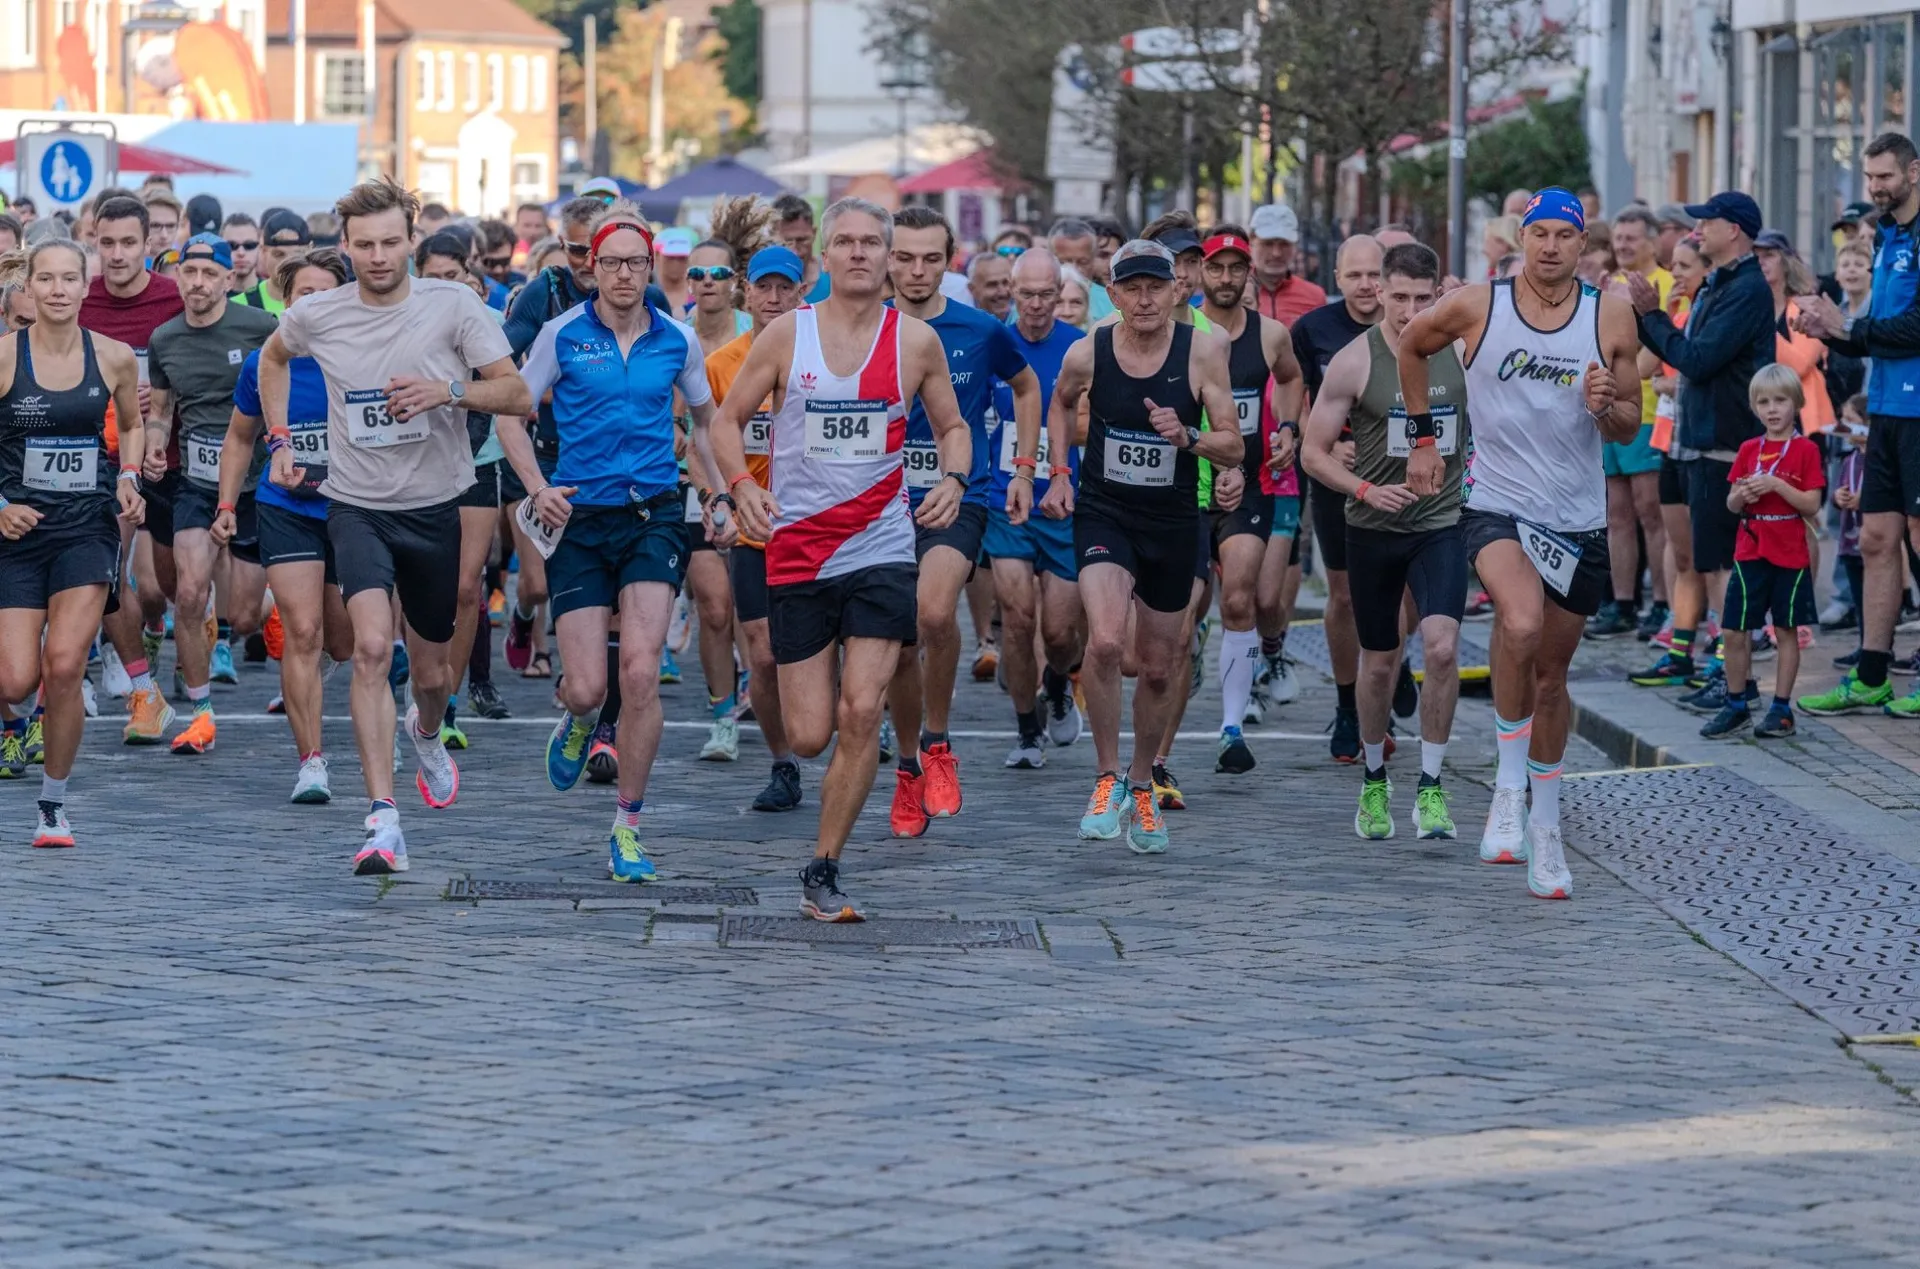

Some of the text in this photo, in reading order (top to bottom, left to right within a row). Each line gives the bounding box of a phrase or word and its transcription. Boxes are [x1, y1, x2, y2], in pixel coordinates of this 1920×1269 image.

[822, 415, 870, 440] 584
[1109, 428, 1169, 443] Preetzer Schuster
[30, 437, 95, 446] Preetzer Schusterlauf
[291, 432, 329, 452] 591
[809, 446, 834, 454] KRIWAT
[42, 451, 83, 473] 705
[197, 447, 221, 466] 63
[1118, 444, 1162, 469] 638
[1529, 533, 1565, 571] 635
